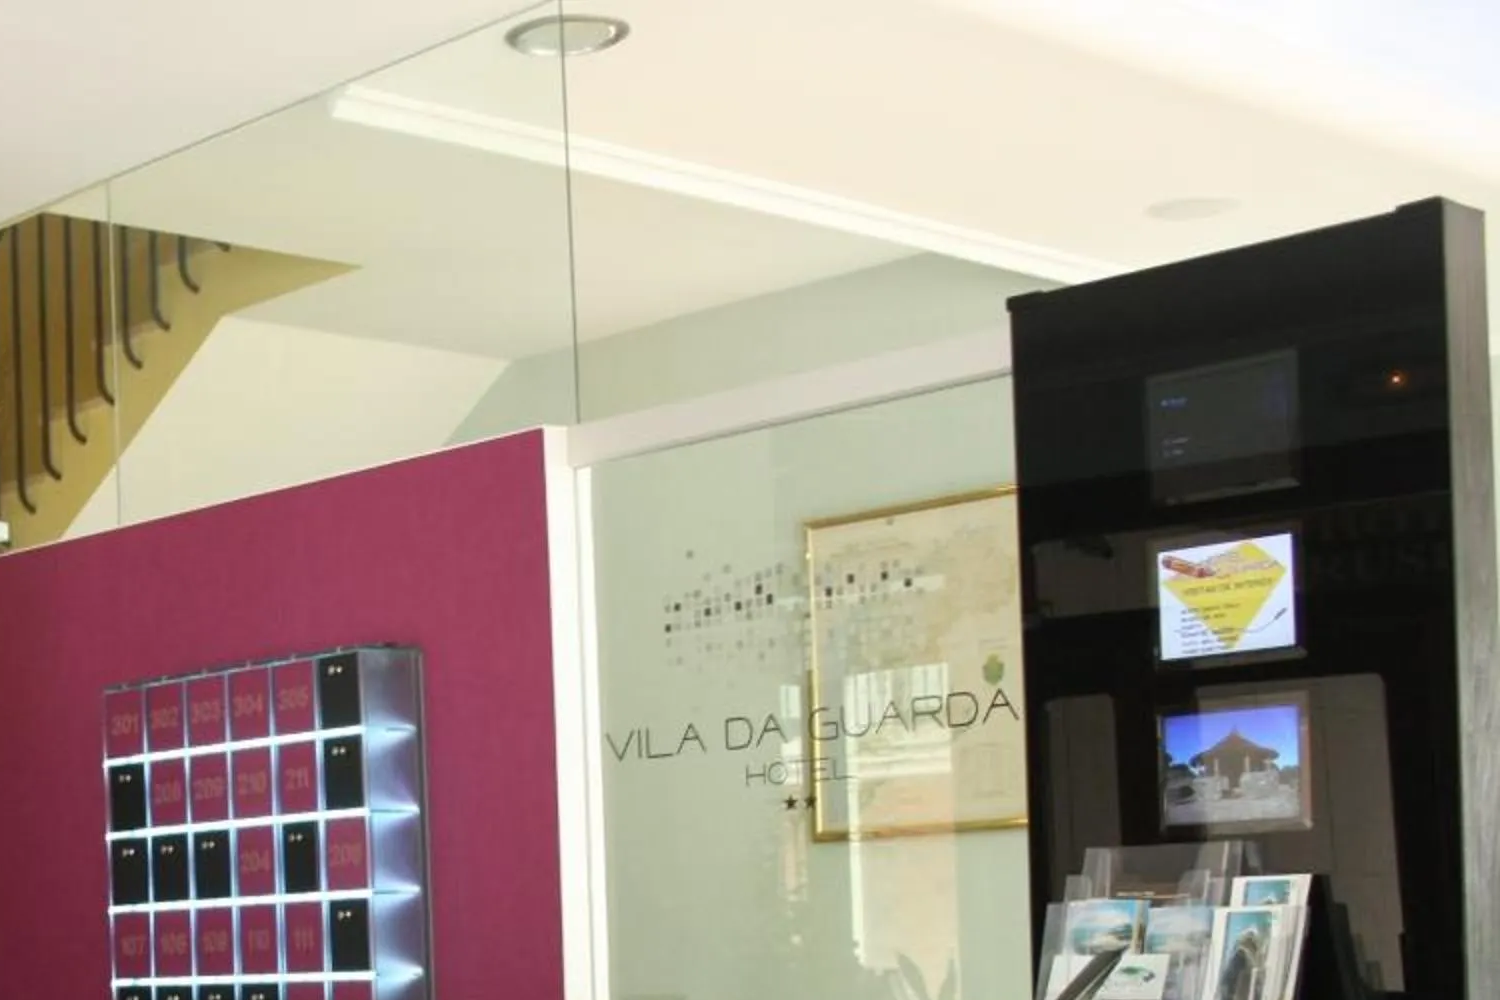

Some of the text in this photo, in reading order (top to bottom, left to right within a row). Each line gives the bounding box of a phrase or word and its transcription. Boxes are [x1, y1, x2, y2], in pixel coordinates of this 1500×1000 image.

[232, 693, 263, 718] 304
[110, 713, 139, 736] 301
[604, 687, 1021, 762] VILA DA GUARDA
[285, 766, 310, 791] 211
[239, 850, 270, 873] 204
